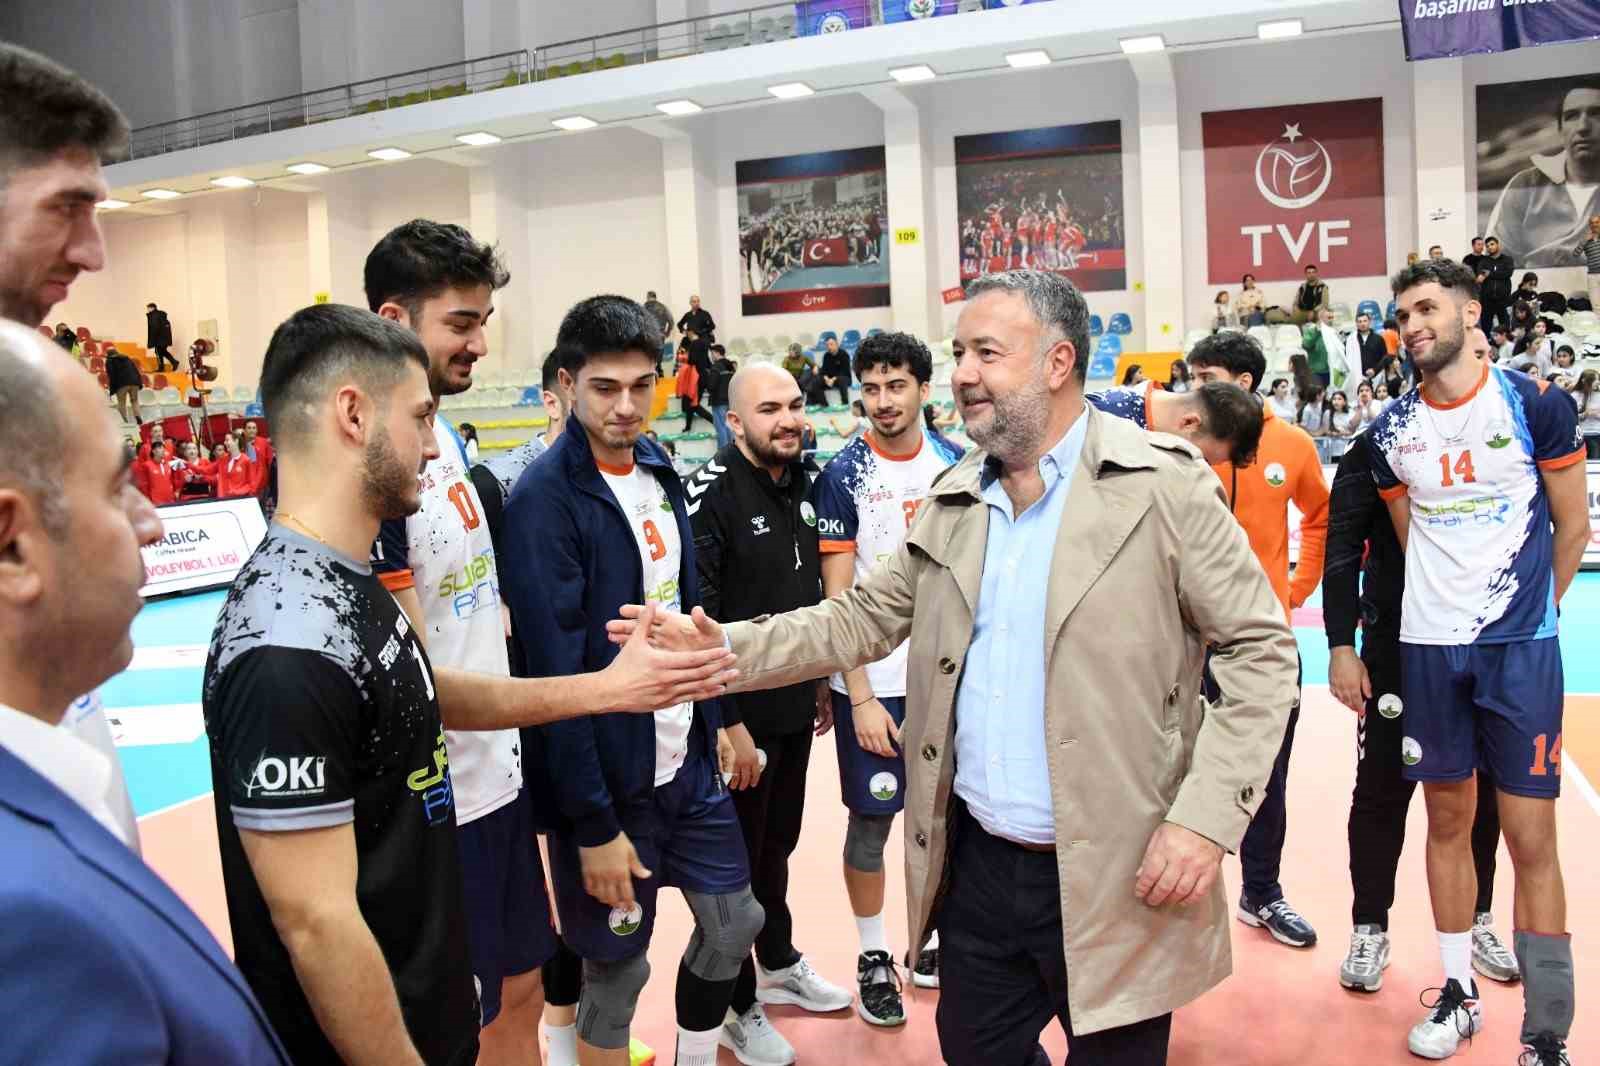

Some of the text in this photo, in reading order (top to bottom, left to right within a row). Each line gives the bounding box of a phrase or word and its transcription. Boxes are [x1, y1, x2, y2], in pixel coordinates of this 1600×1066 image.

[898, 231, 916, 241] 109
[1240, 220, 1350, 267] TVF
[1439, 449, 1477, 487] 14
[447, 481, 481, 534] 10
[642, 519, 668, 562] 9
